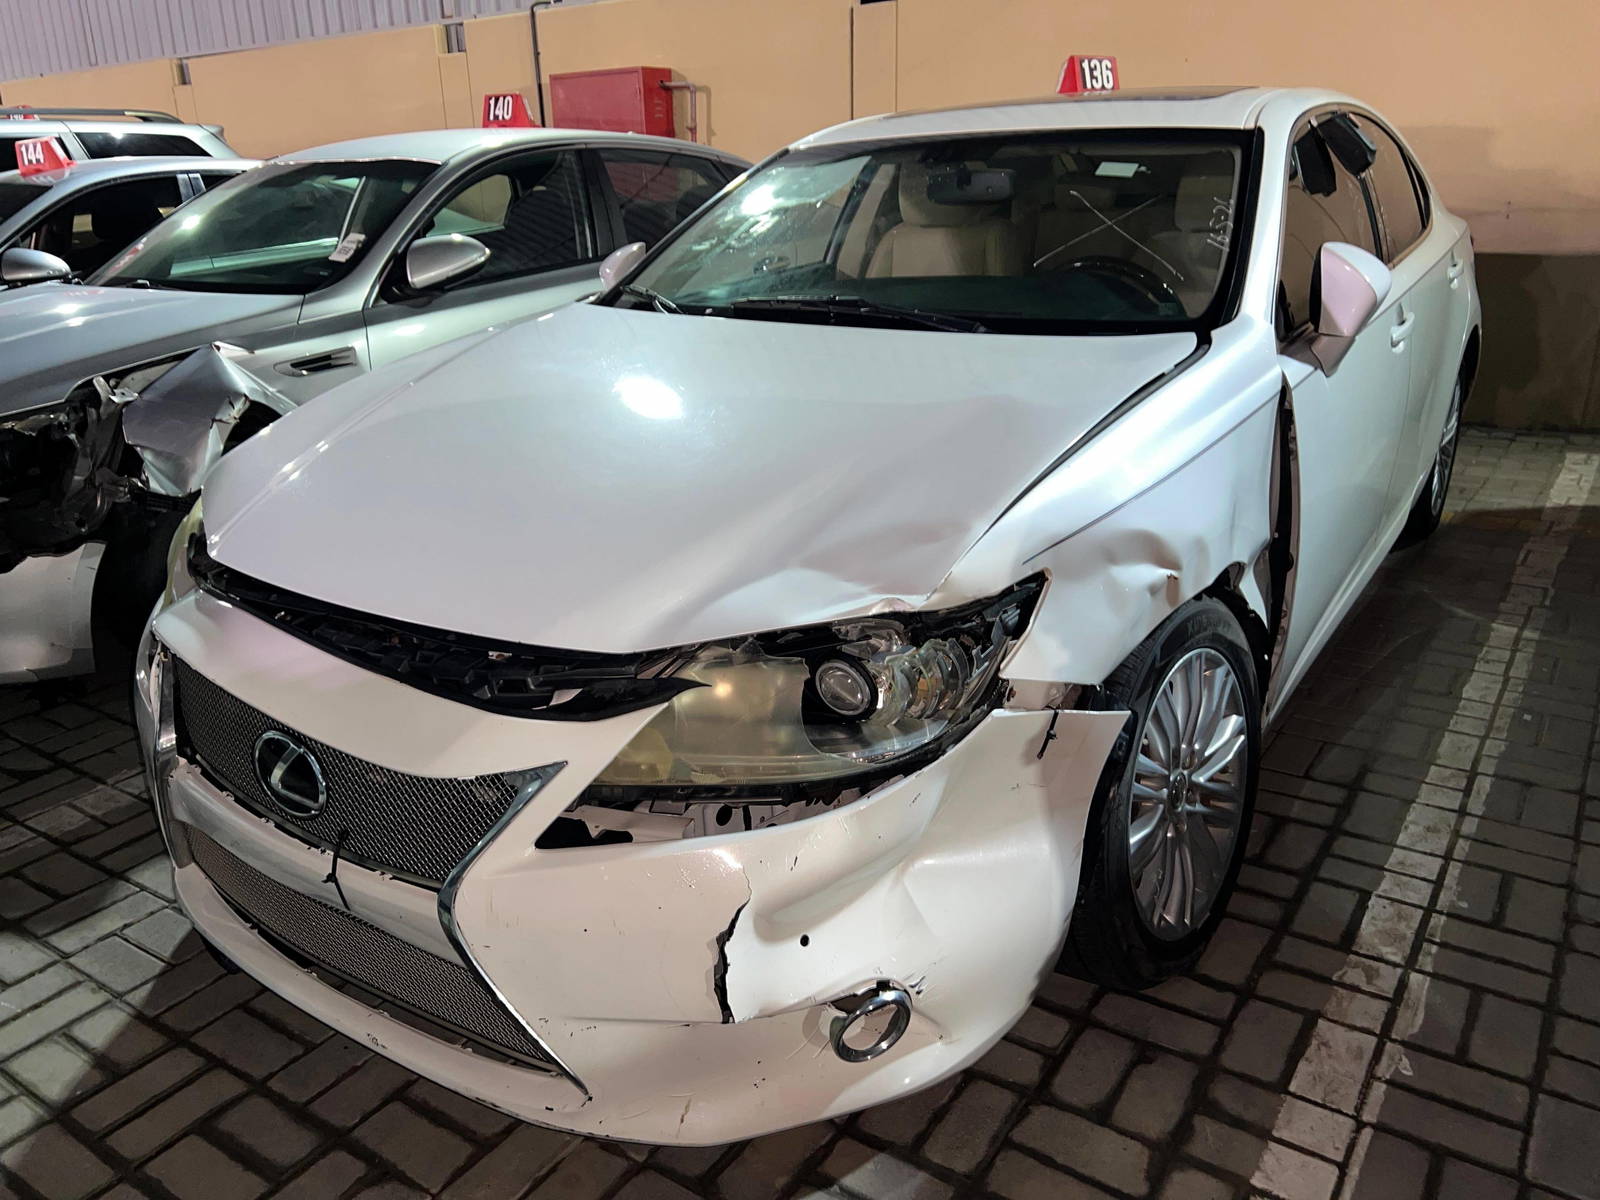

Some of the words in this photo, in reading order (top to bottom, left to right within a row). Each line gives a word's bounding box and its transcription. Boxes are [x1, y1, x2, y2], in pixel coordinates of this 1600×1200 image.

[1082, 59, 1113, 89] 136
[489, 96, 512, 121] 140
[21, 142, 44, 166] 144
